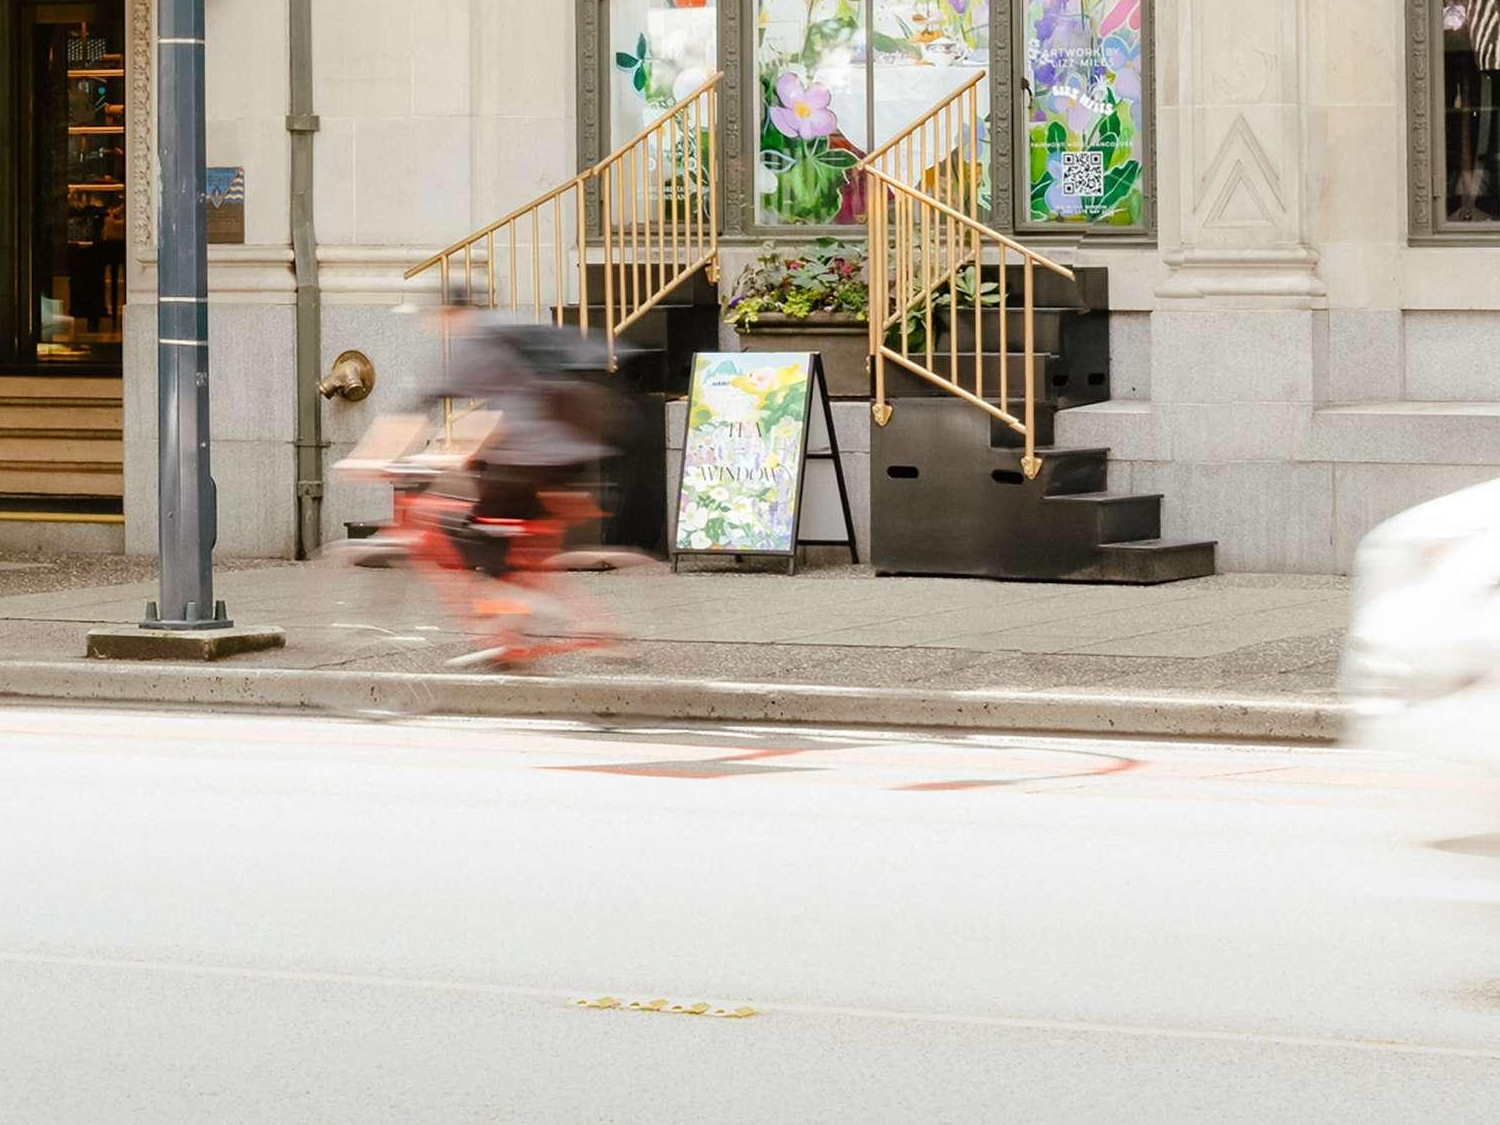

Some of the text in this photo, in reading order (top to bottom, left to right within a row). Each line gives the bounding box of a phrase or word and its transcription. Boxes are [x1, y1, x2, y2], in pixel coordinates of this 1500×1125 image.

[1043, 47, 1120, 58] ARTWORK BY
[698, 466, 780, 482] WINDOW
